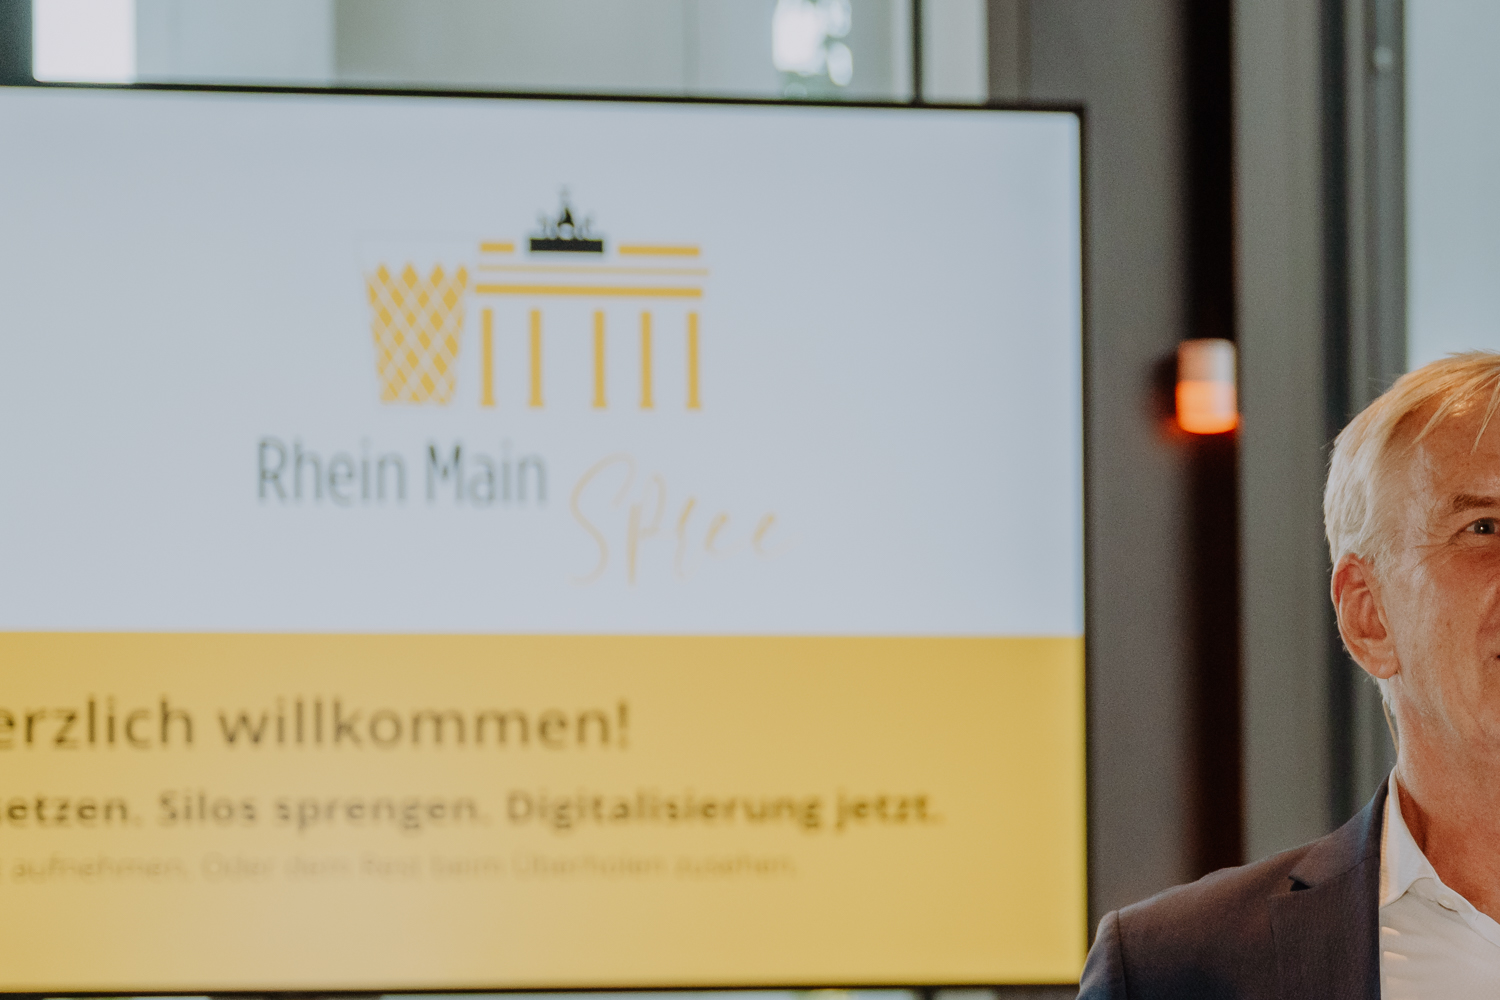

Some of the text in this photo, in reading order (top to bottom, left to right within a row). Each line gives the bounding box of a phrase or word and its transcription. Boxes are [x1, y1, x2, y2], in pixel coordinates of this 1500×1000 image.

[257, 436, 408, 506] Rhein
[425, 437, 550, 508] Main
[217, 695, 631, 751] willkommen!
[0, 786, 945, 837] etzen. Silos sprengen. Digitalisierung jetzt.
